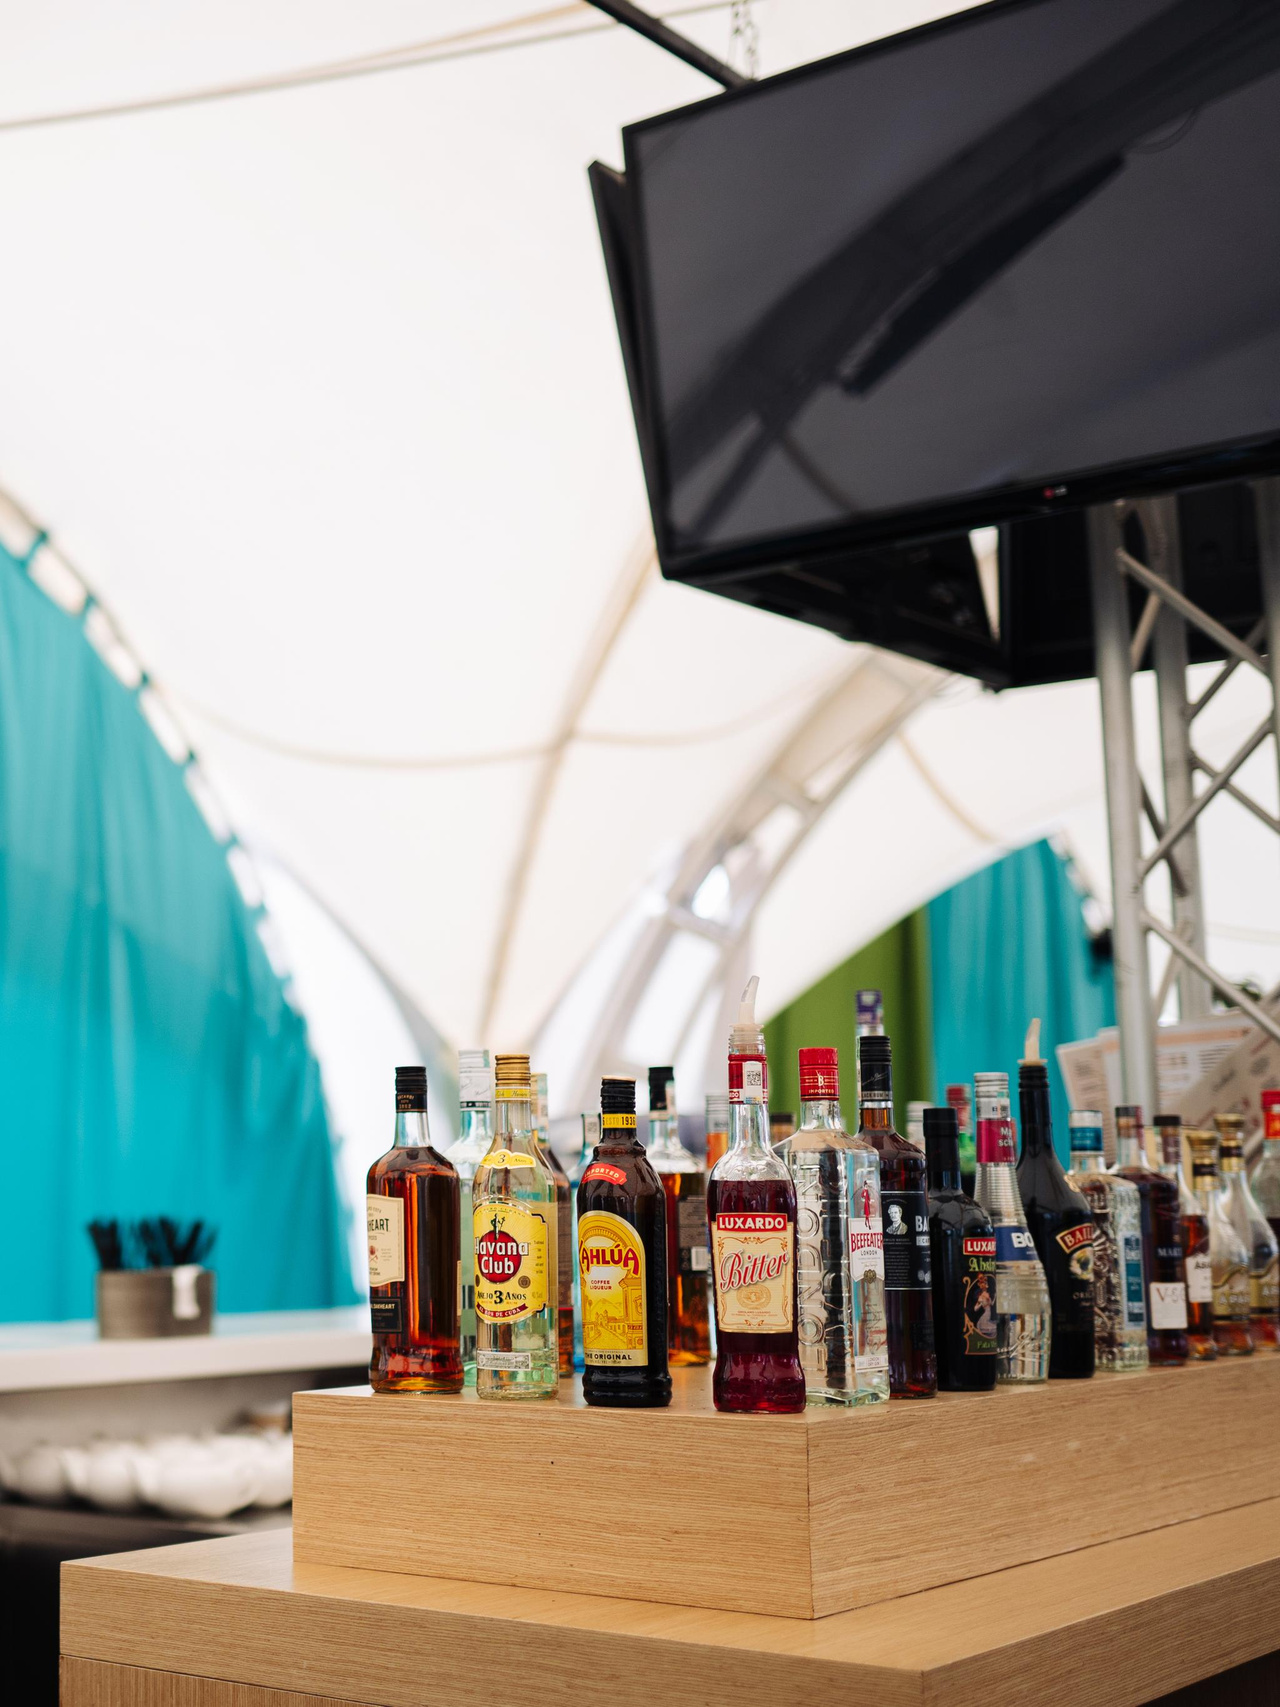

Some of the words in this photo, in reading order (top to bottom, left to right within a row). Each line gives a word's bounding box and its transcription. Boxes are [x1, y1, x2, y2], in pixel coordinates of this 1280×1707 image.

[497, 1153, 506, 1164] 3
[584, 1167, 620, 1179] IMPORTED
[718, 1216, 785, 1230] LUXARDO
[475, 1236, 530, 1256] Havana
[850, 1232, 884, 1253] BEEFEATER
[481, 1256, 515, 1274] Club
[720, 1249, 789, 1292] Bitter
[493, 1289, 504, 1305] 3
[505, 1291, 527, 1300] AÑOS
[505, 1307, 521, 1316] CUBA
[594, 1353, 632, 1361] ORIGINAL
